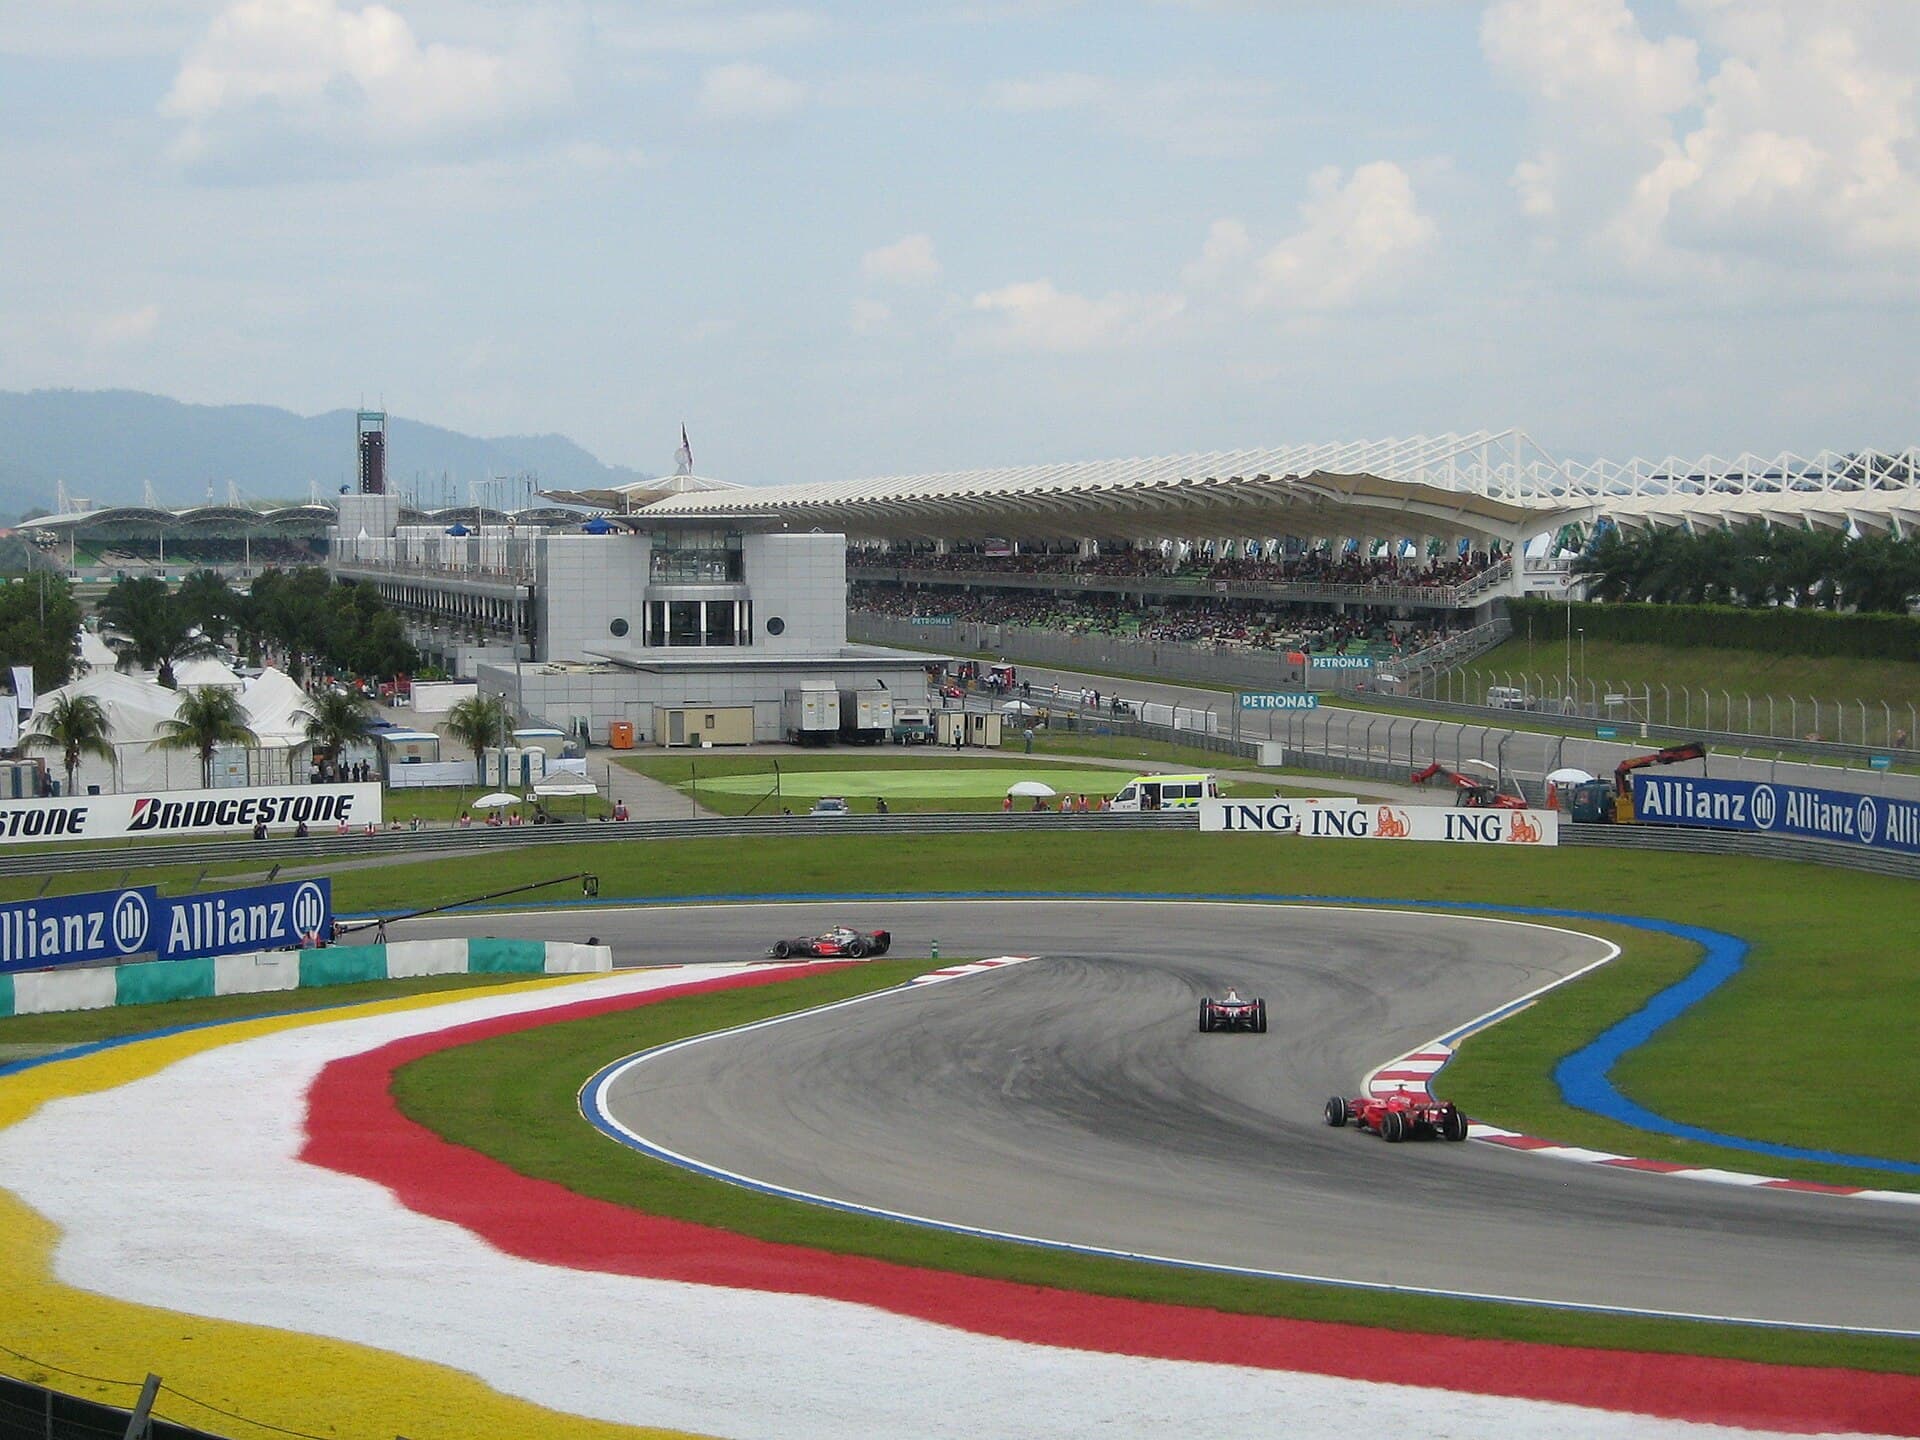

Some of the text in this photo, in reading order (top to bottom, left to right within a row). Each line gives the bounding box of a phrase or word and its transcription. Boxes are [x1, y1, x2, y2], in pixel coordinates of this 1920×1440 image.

[1312, 657, 1369, 668] PETRONAS
[1242, 695, 1316, 708] PETRONAS
[126, 794, 354, 831] BRIDGESTONE
[1222, 805, 1293, 830] ING
[1642, 781, 1746, 822] Allianz
[1785, 790, 1854, 835] Allianz
[1311, 810, 1369, 836] ING
[1444, 814, 1502, 841] ING
[0, 908, 105, 962] llianz
[168, 899, 286, 954] Allianz
